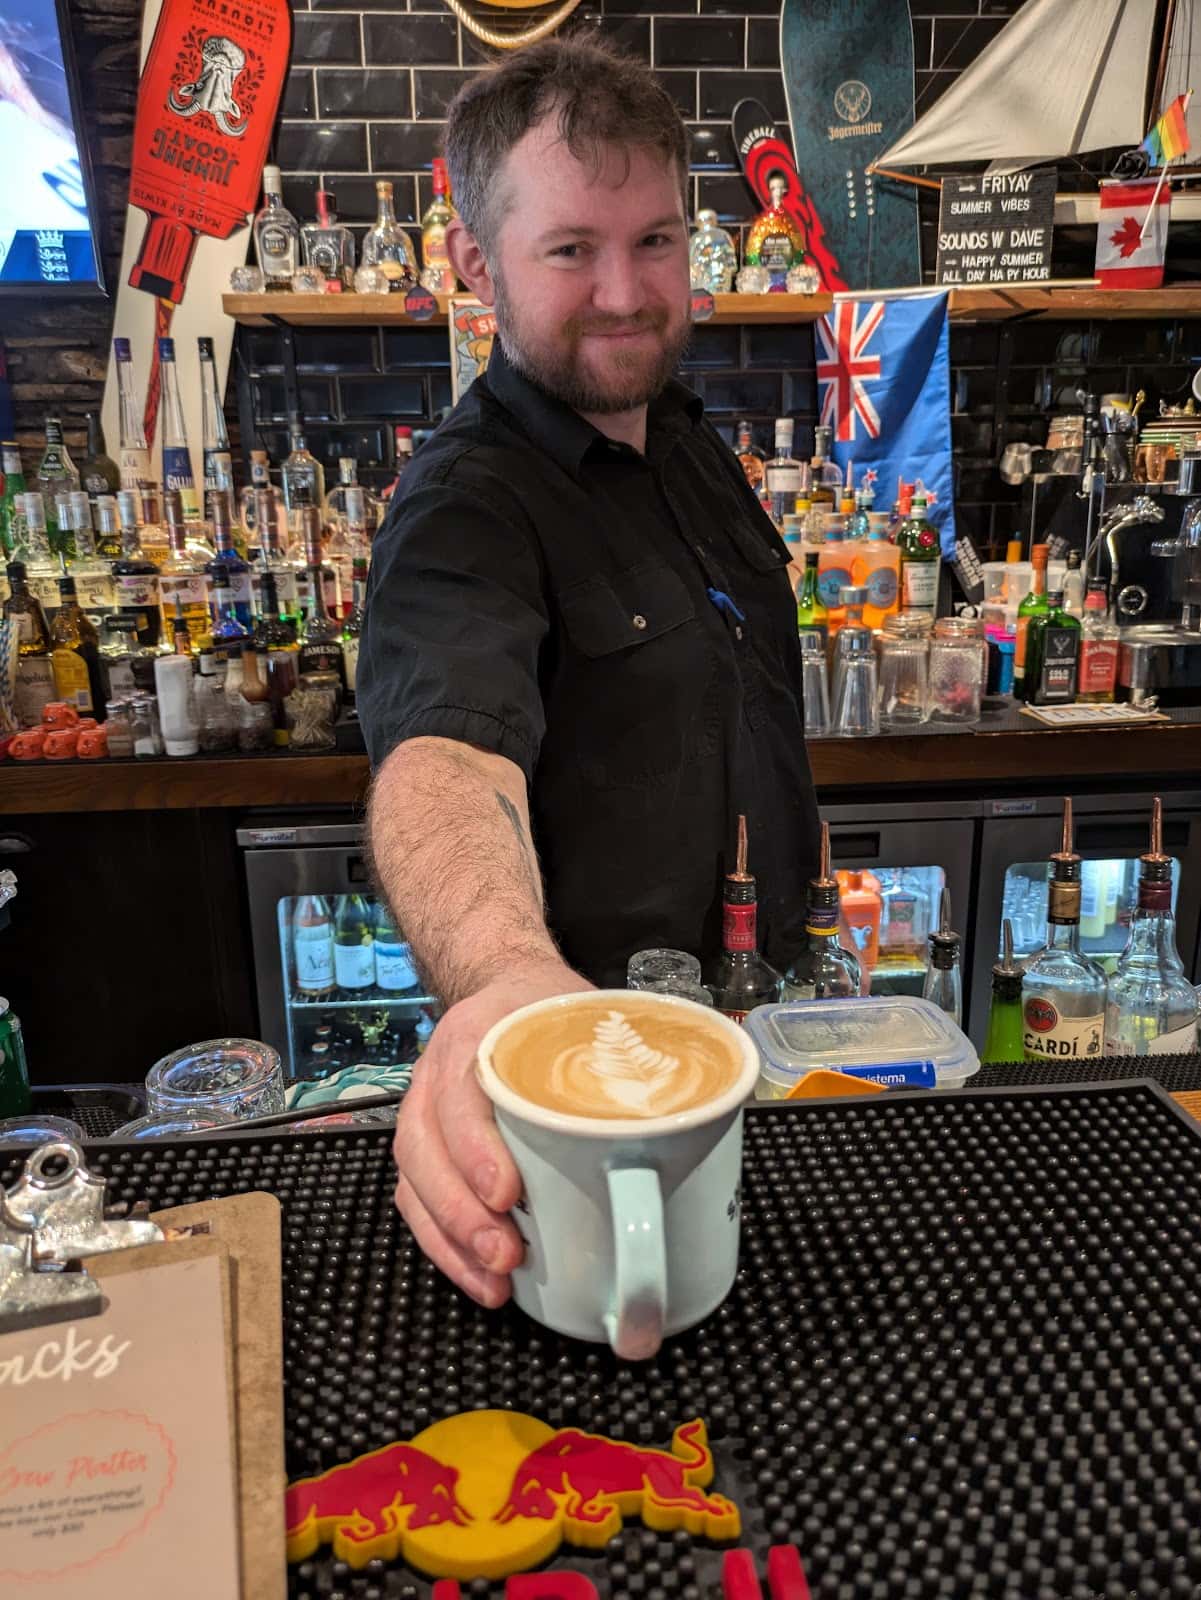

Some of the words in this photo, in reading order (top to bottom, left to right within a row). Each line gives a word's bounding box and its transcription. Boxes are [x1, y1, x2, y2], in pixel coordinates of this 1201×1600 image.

[170, 129, 232, 163] GOAT
[149, 128, 240, 187] JUMPING
[981, 174, 1033, 194] FRIYAY
[950, 201, 992, 215] SUMMER
[1000, 198, 1031, 212] VIBES
[939, 232, 988, 250] SOUNDS
[991, 231, 1004, 248] W
[1010, 229, 1045, 248] DAVE
[962, 255, 995, 268] HAPPY
[1000, 252, 1043, 266] SUMMER
[942, 270, 962, 284] ALL
[966, 269, 985, 283] DAY
[1022, 267, 1049, 280] HOUR
[864, 1073, 906, 1085] istema
